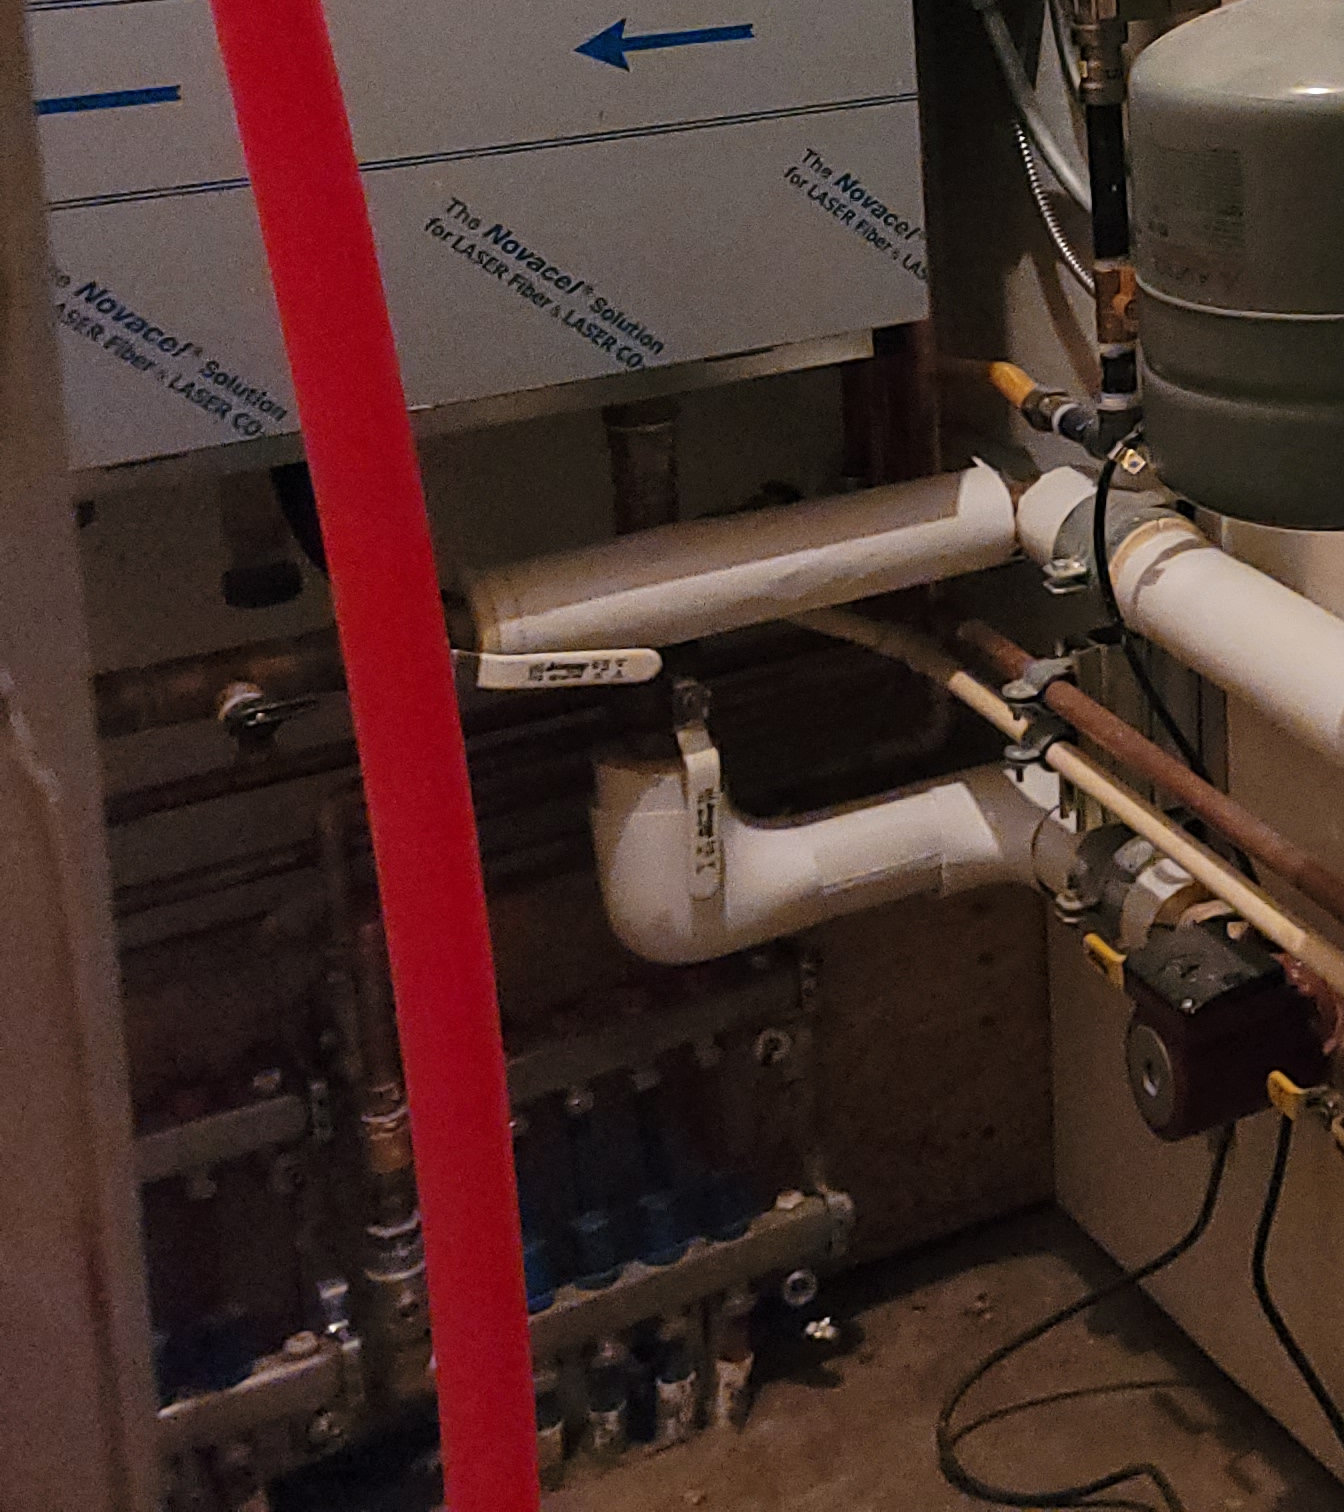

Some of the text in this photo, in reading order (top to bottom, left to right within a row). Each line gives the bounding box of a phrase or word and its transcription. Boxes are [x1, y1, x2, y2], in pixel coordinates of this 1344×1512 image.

[802, 148, 833, 179] The
[784, 166, 809, 188] for
[807, 184, 857, 226] LASER
[855, 219, 893, 252] Fiber
[424, 217, 453, 242] for
[451, 235, 509, 280] LASER
[508, 273, 554, 309] Fiber
[562, 309, 618, 353] LASER
[447, 196, 481, 231] The
[589, 297, 665, 355] Solution
[103, 335, 156, 372] Fiber
[168, 374, 233, 420] LASER
[200, 360, 287, 422] Solution
